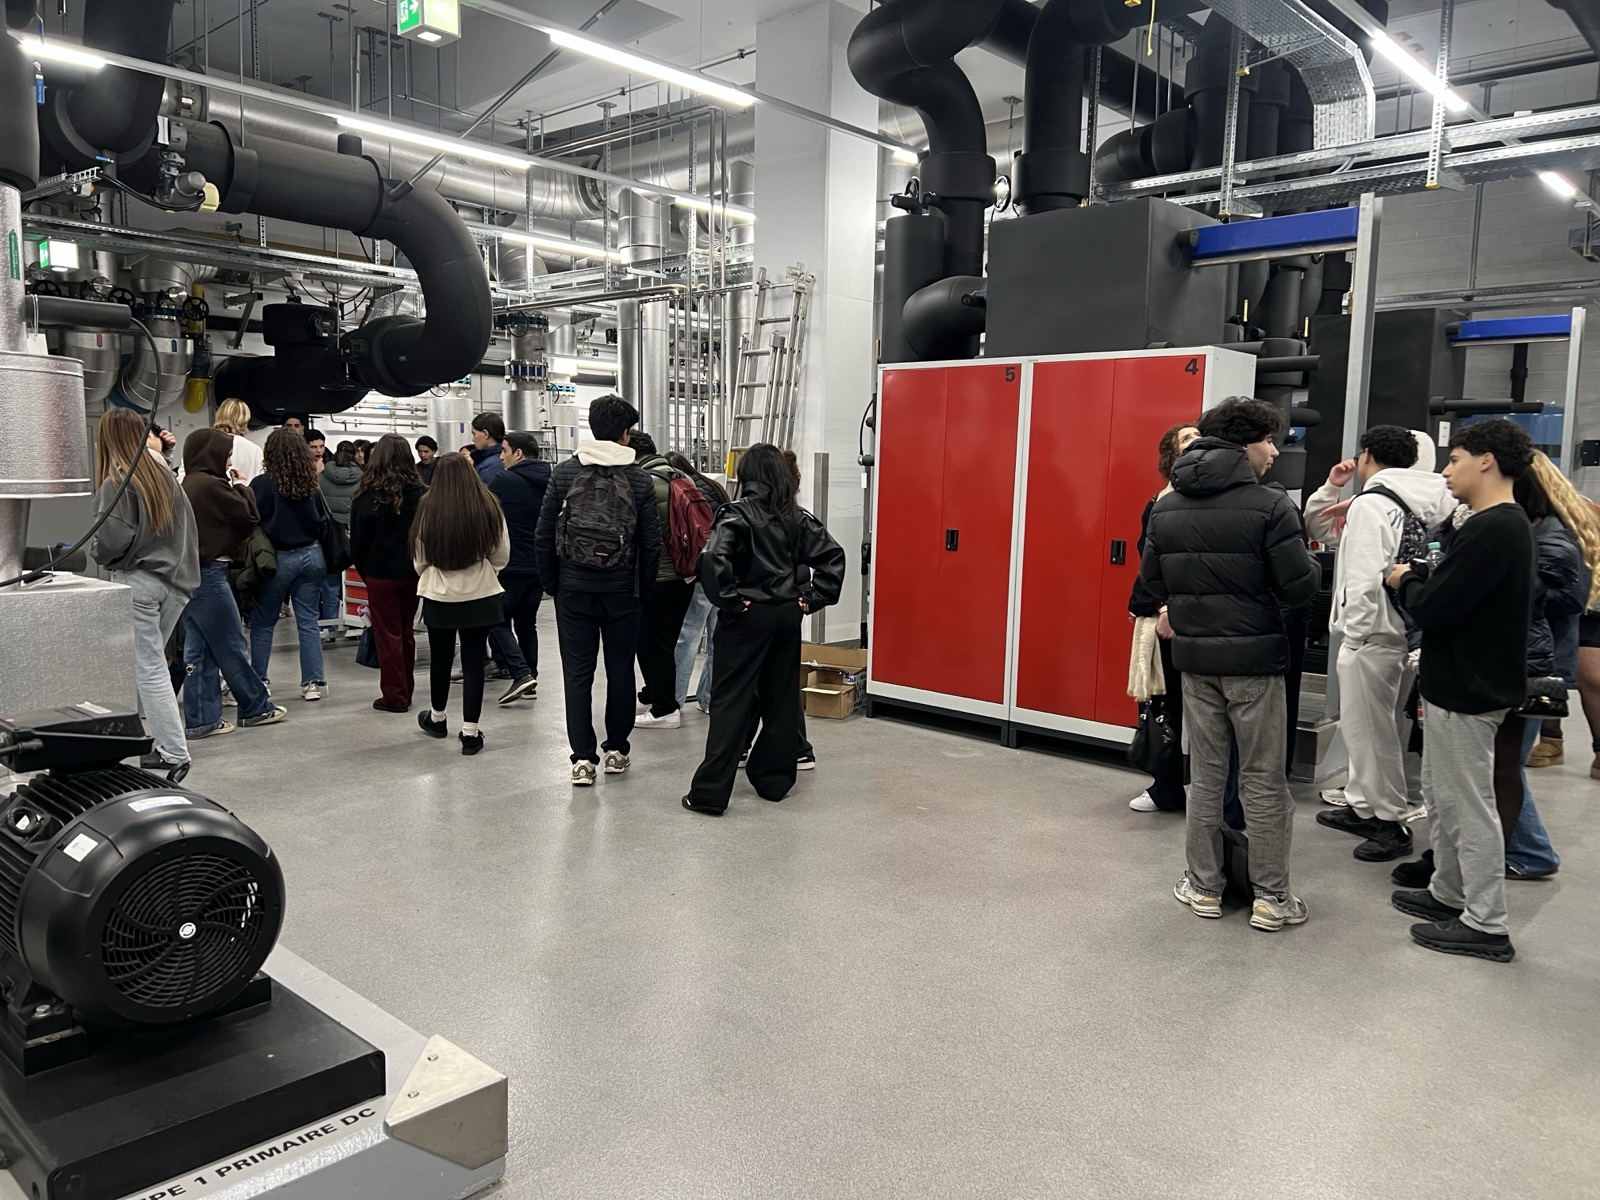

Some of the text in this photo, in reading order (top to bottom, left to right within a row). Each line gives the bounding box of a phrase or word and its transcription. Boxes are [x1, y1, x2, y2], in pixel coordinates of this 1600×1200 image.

[1005, 366, 1016, 382] 5
[1184, 357, 1199, 375] 4
[140, 1108, 376, 1200] PE 1 PRIMAIRE DC
